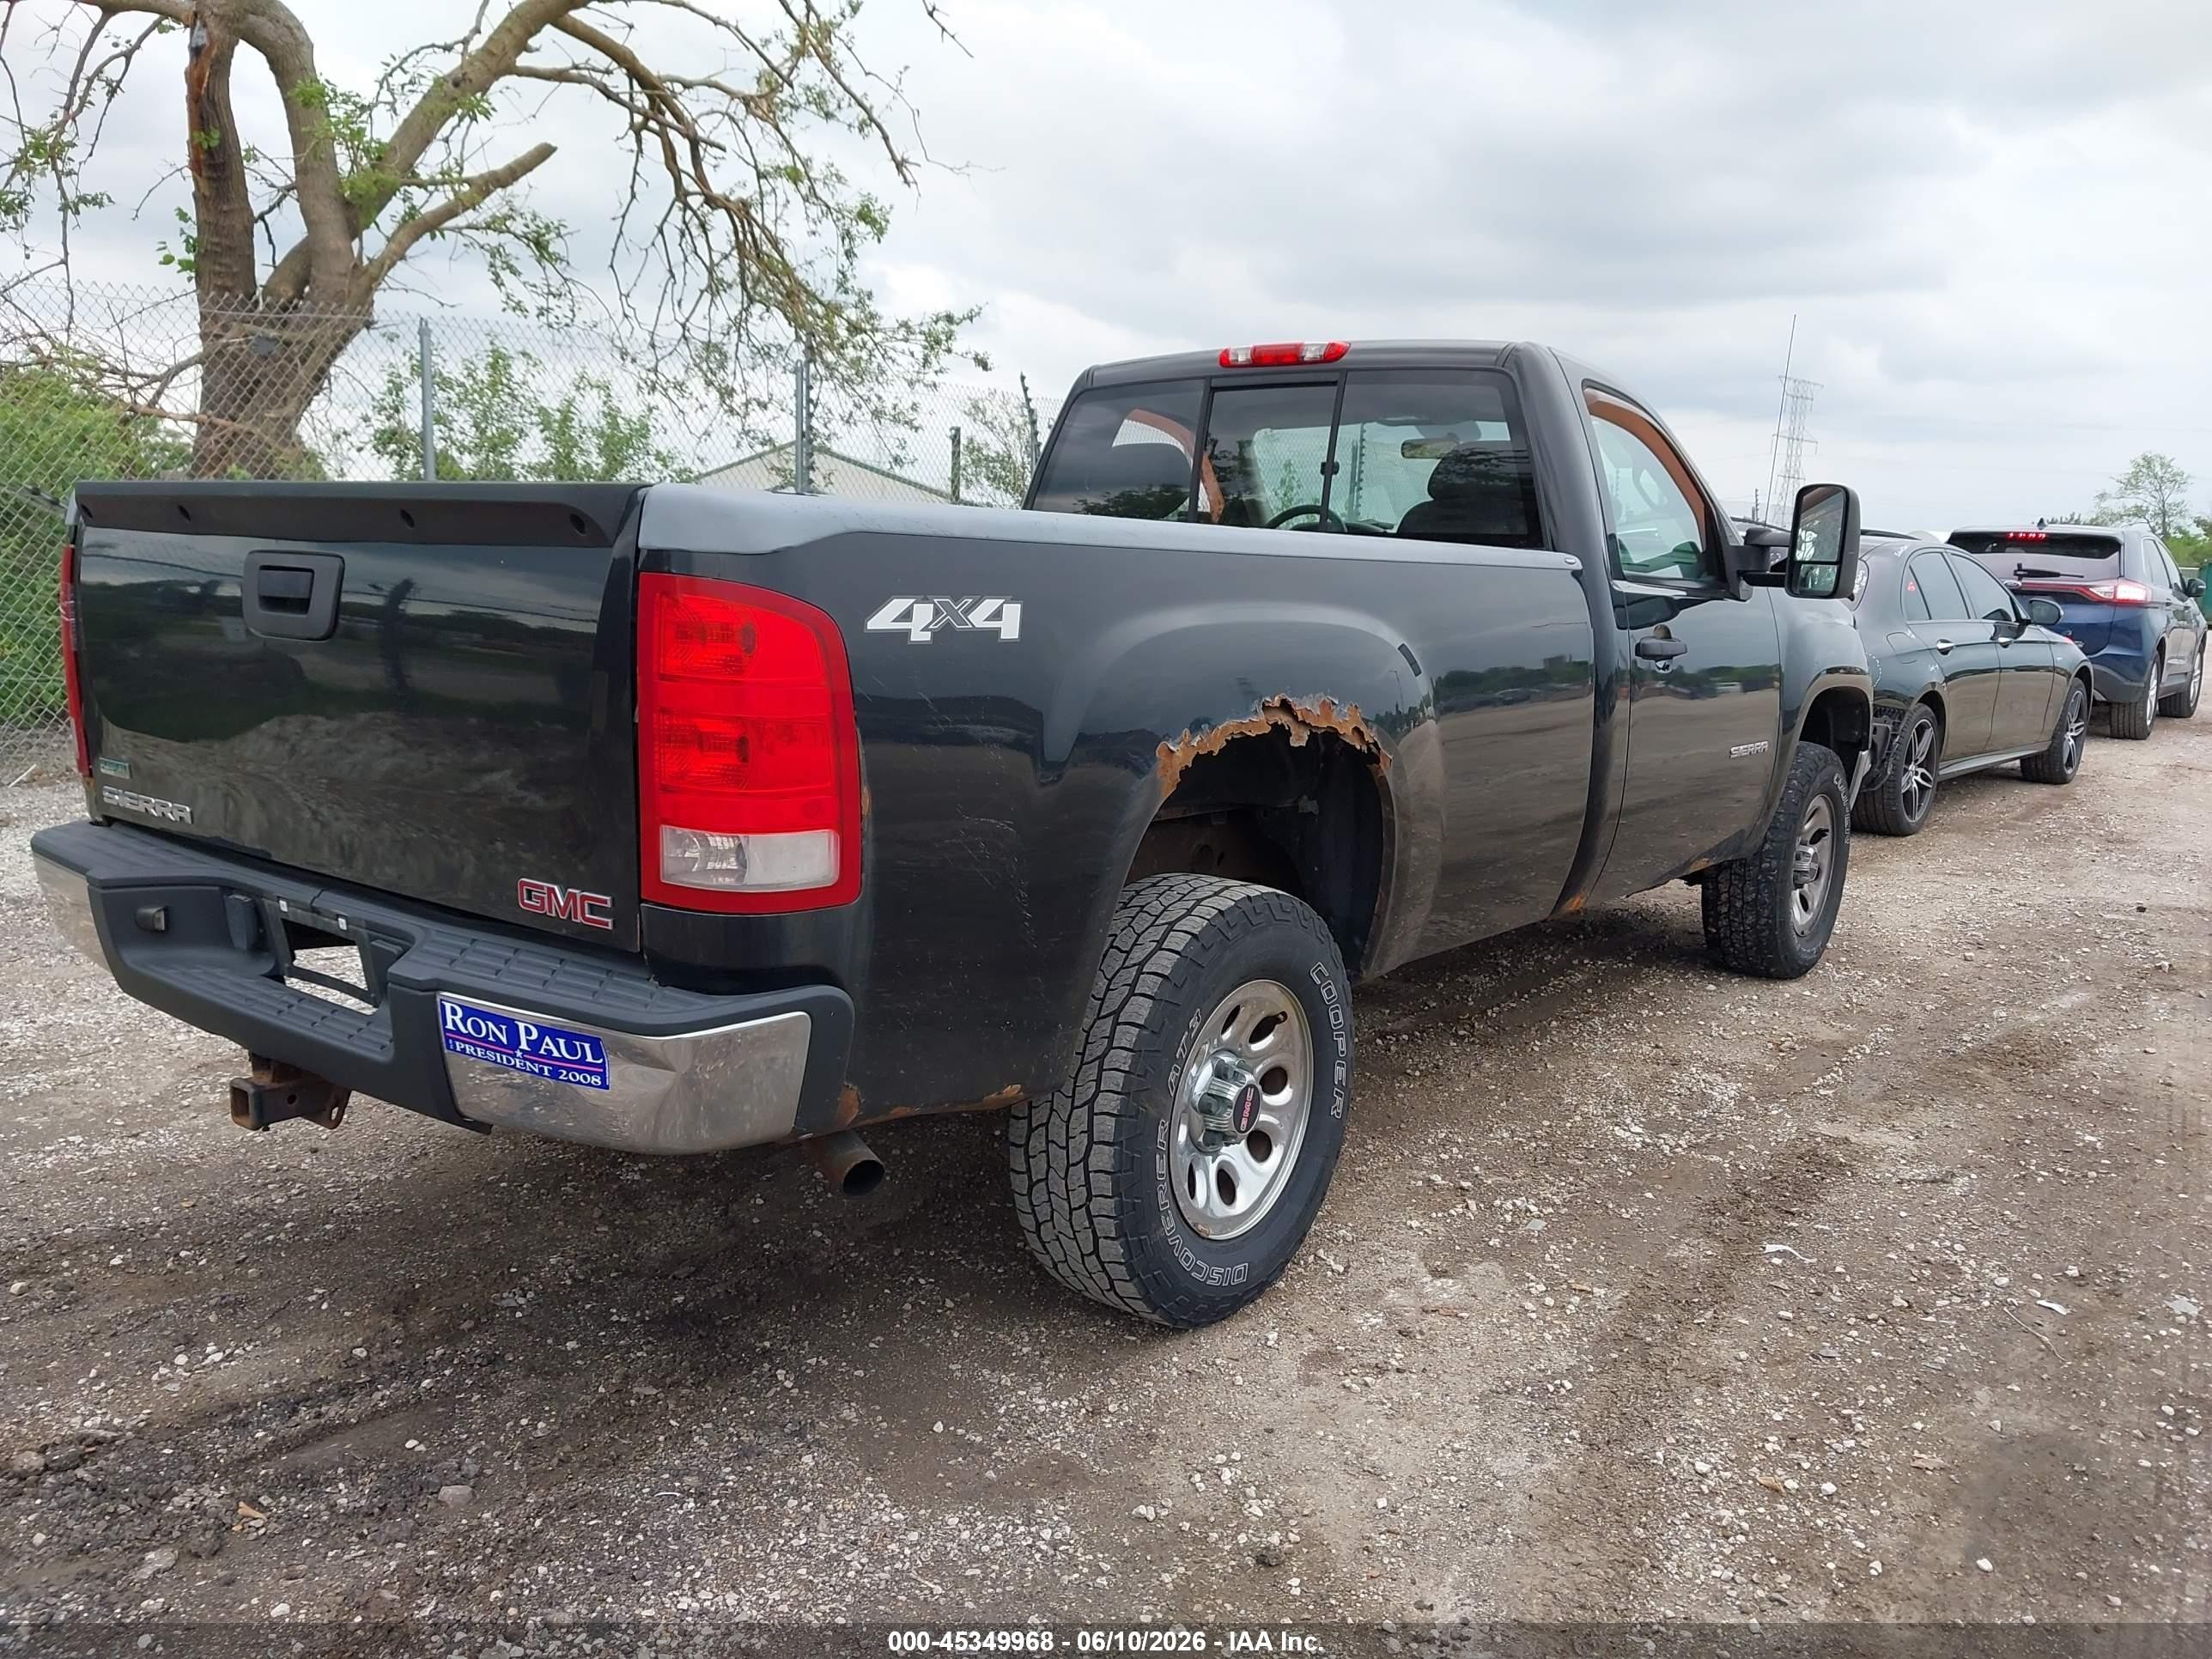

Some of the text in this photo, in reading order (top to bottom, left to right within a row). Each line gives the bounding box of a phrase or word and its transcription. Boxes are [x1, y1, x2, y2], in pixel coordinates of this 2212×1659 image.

[1729, 740, 1769, 759] SIERRA
[102, 785, 193, 825] SIERRA
[517, 878, 613, 930] GMC
[455, 1040, 553, 1077] PRESIDENT
[558, 1069, 602, 1086] 2008
[1310, 961, 1346, 1120] COOPER
[1241, 1086, 1255, 1132] GMC
[1156, 1119, 1249, 1286] DISCOVERER
